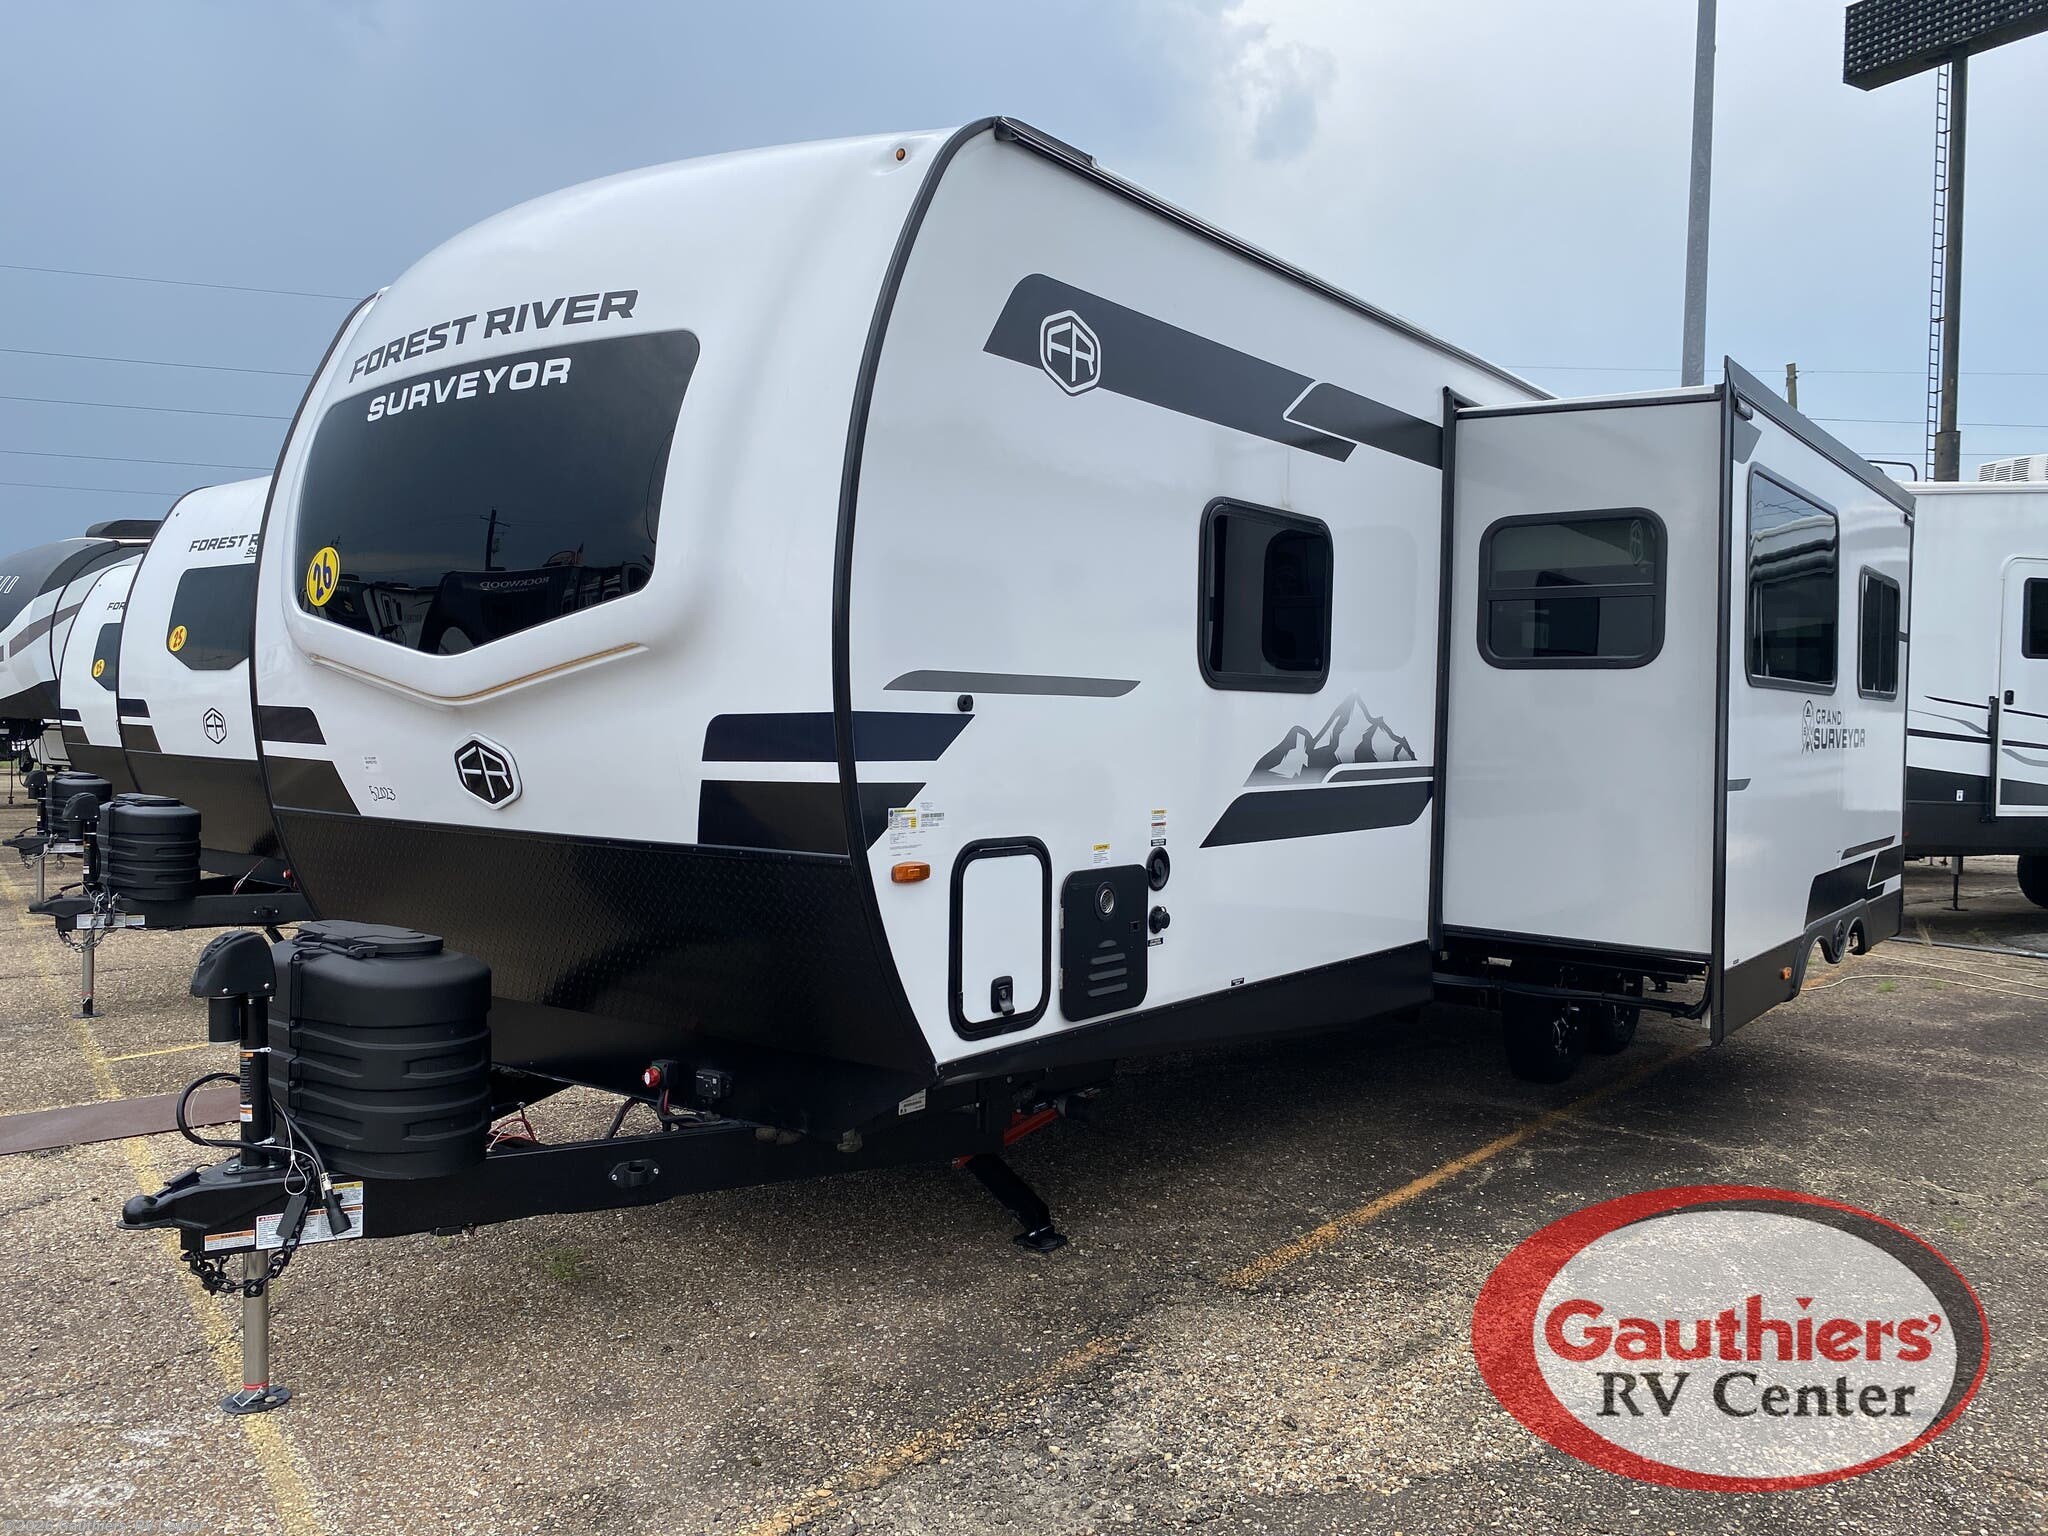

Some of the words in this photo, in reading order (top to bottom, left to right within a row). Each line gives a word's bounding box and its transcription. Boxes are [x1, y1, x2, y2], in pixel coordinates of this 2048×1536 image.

[349, 314, 477, 383] FOREST
[484, 289, 639, 339] RIVER
[366, 357, 572, 422] SURVEYOR
[188, 535, 248, 552] FOREST
[313, 552, 332, 601] 26
[1816, 709, 1842, 725] GRAND
[1814, 728, 1866, 749] SURVEYOR
